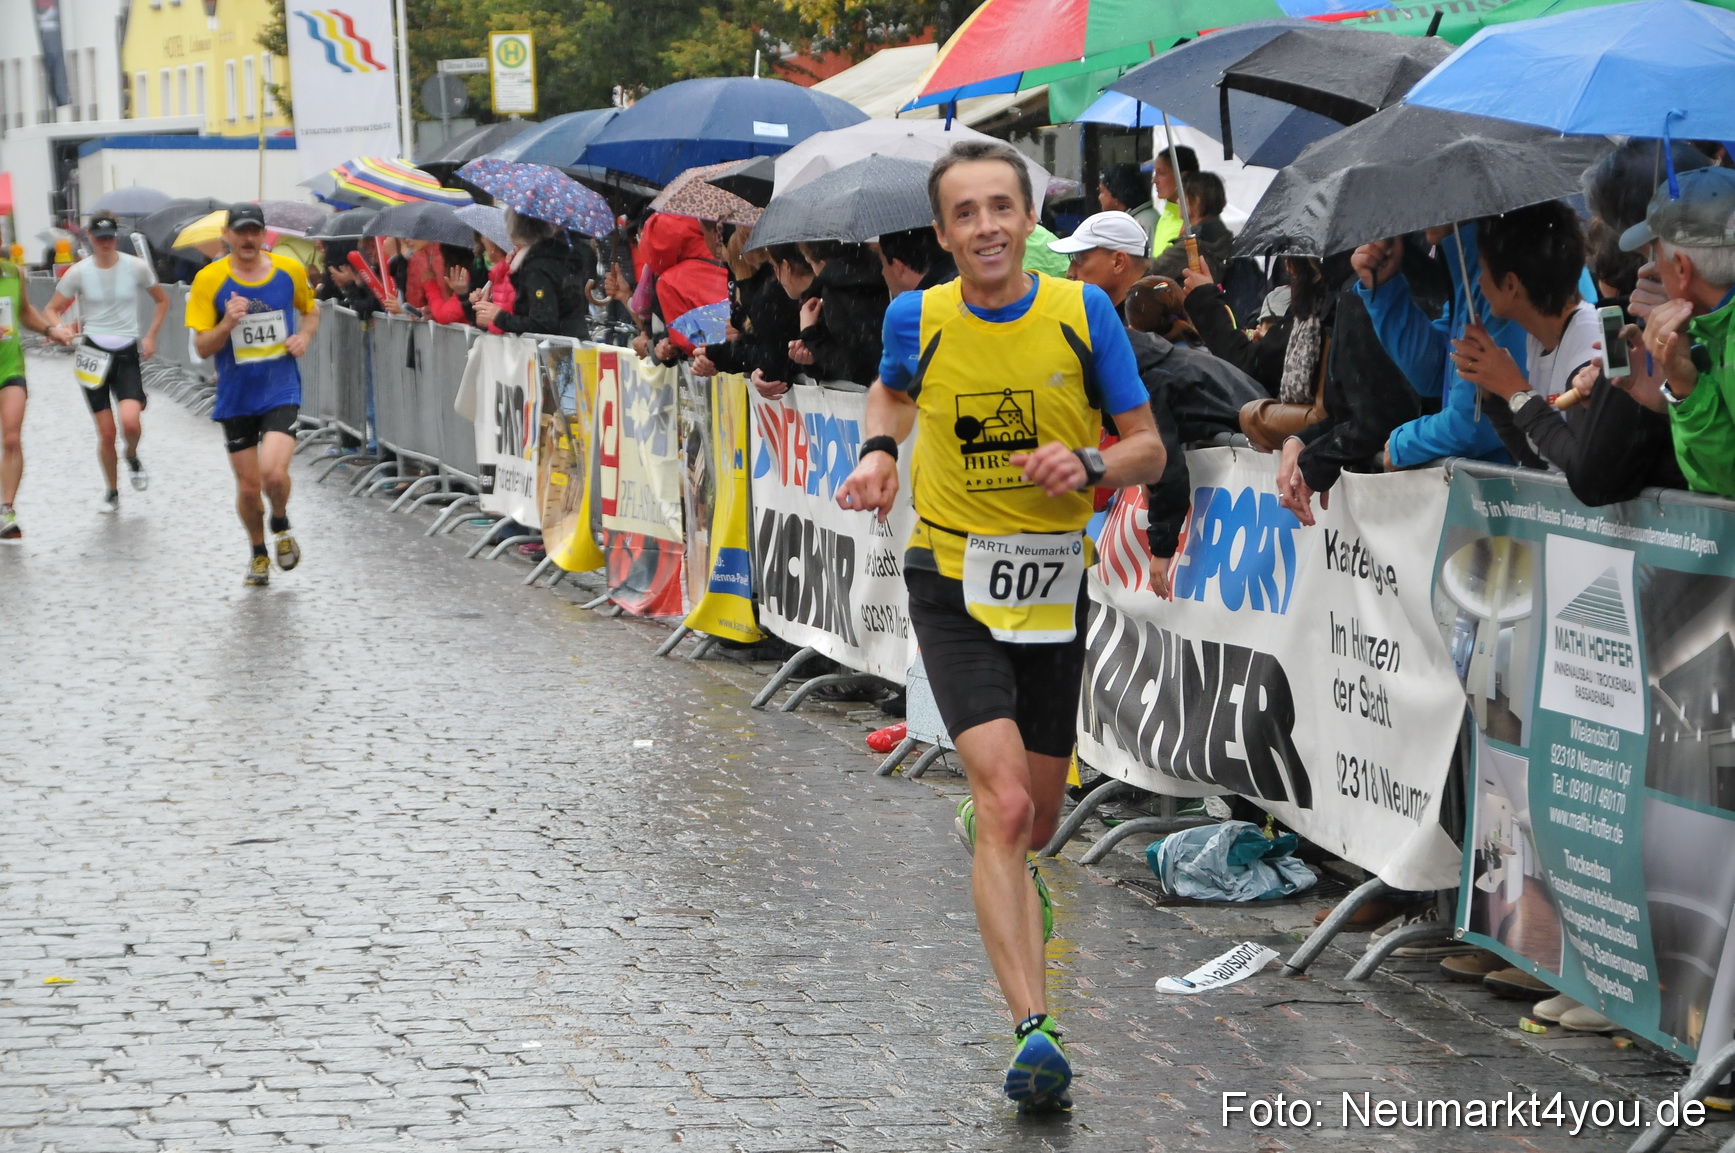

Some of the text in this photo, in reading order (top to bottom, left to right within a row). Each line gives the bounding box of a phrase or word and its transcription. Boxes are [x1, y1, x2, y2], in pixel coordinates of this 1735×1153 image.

[162, 34, 184, 58] HOTEL
[243, 324, 276, 344] 644
[75, 354, 98, 372] 646
[965, 453, 1012, 470] HIRS
[966, 475, 1023, 486] APOTHE
[970, 538, 1070, 556] PARTL Neumarkt
[1690, 533, 1718, 558] Bayern
[989, 560, 1065, 600] 607
[861, 604, 895, 634] 92318
[1330, 611, 1346, 656] Im
[1588, 635, 1634, 669] HOFFER
[1575, 684, 1615, 708] FASSADENBAU
[1596, 672, 1636, 695] TROCKENBAU
[1550, 743, 1576, 769] 92318
[1576, 750, 1613, 780] Neumarkt
[1618, 762, 1633, 789] Opf
[1569, 778, 1593, 804] 09181
[1549, 806, 1624, 845] www.mathi-hoffer.de
[1563, 848, 1612, 884] Trockenbau
[1594, 942, 1649, 983] Sanierungen
